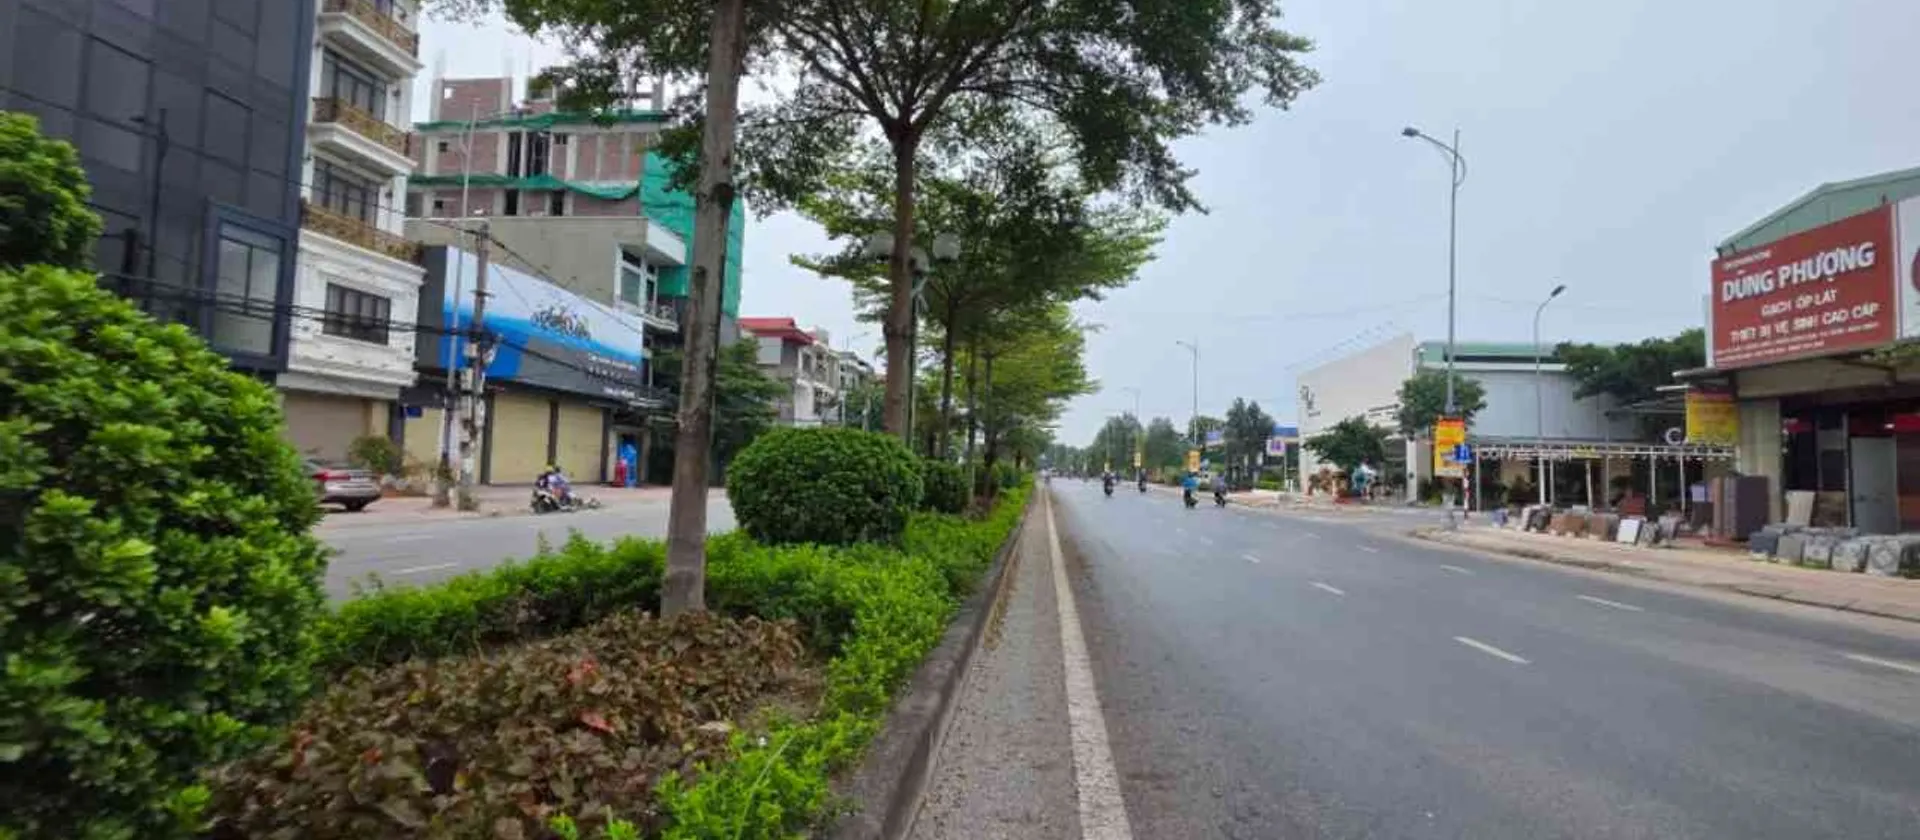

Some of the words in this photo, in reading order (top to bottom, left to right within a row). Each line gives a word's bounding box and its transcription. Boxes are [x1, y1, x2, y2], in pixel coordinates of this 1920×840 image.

[1722, 270, 1774, 302] DŨNG
[1777, 241, 1875, 288] PHƯỢNG
[1822, 308, 1848, 325] CAO
